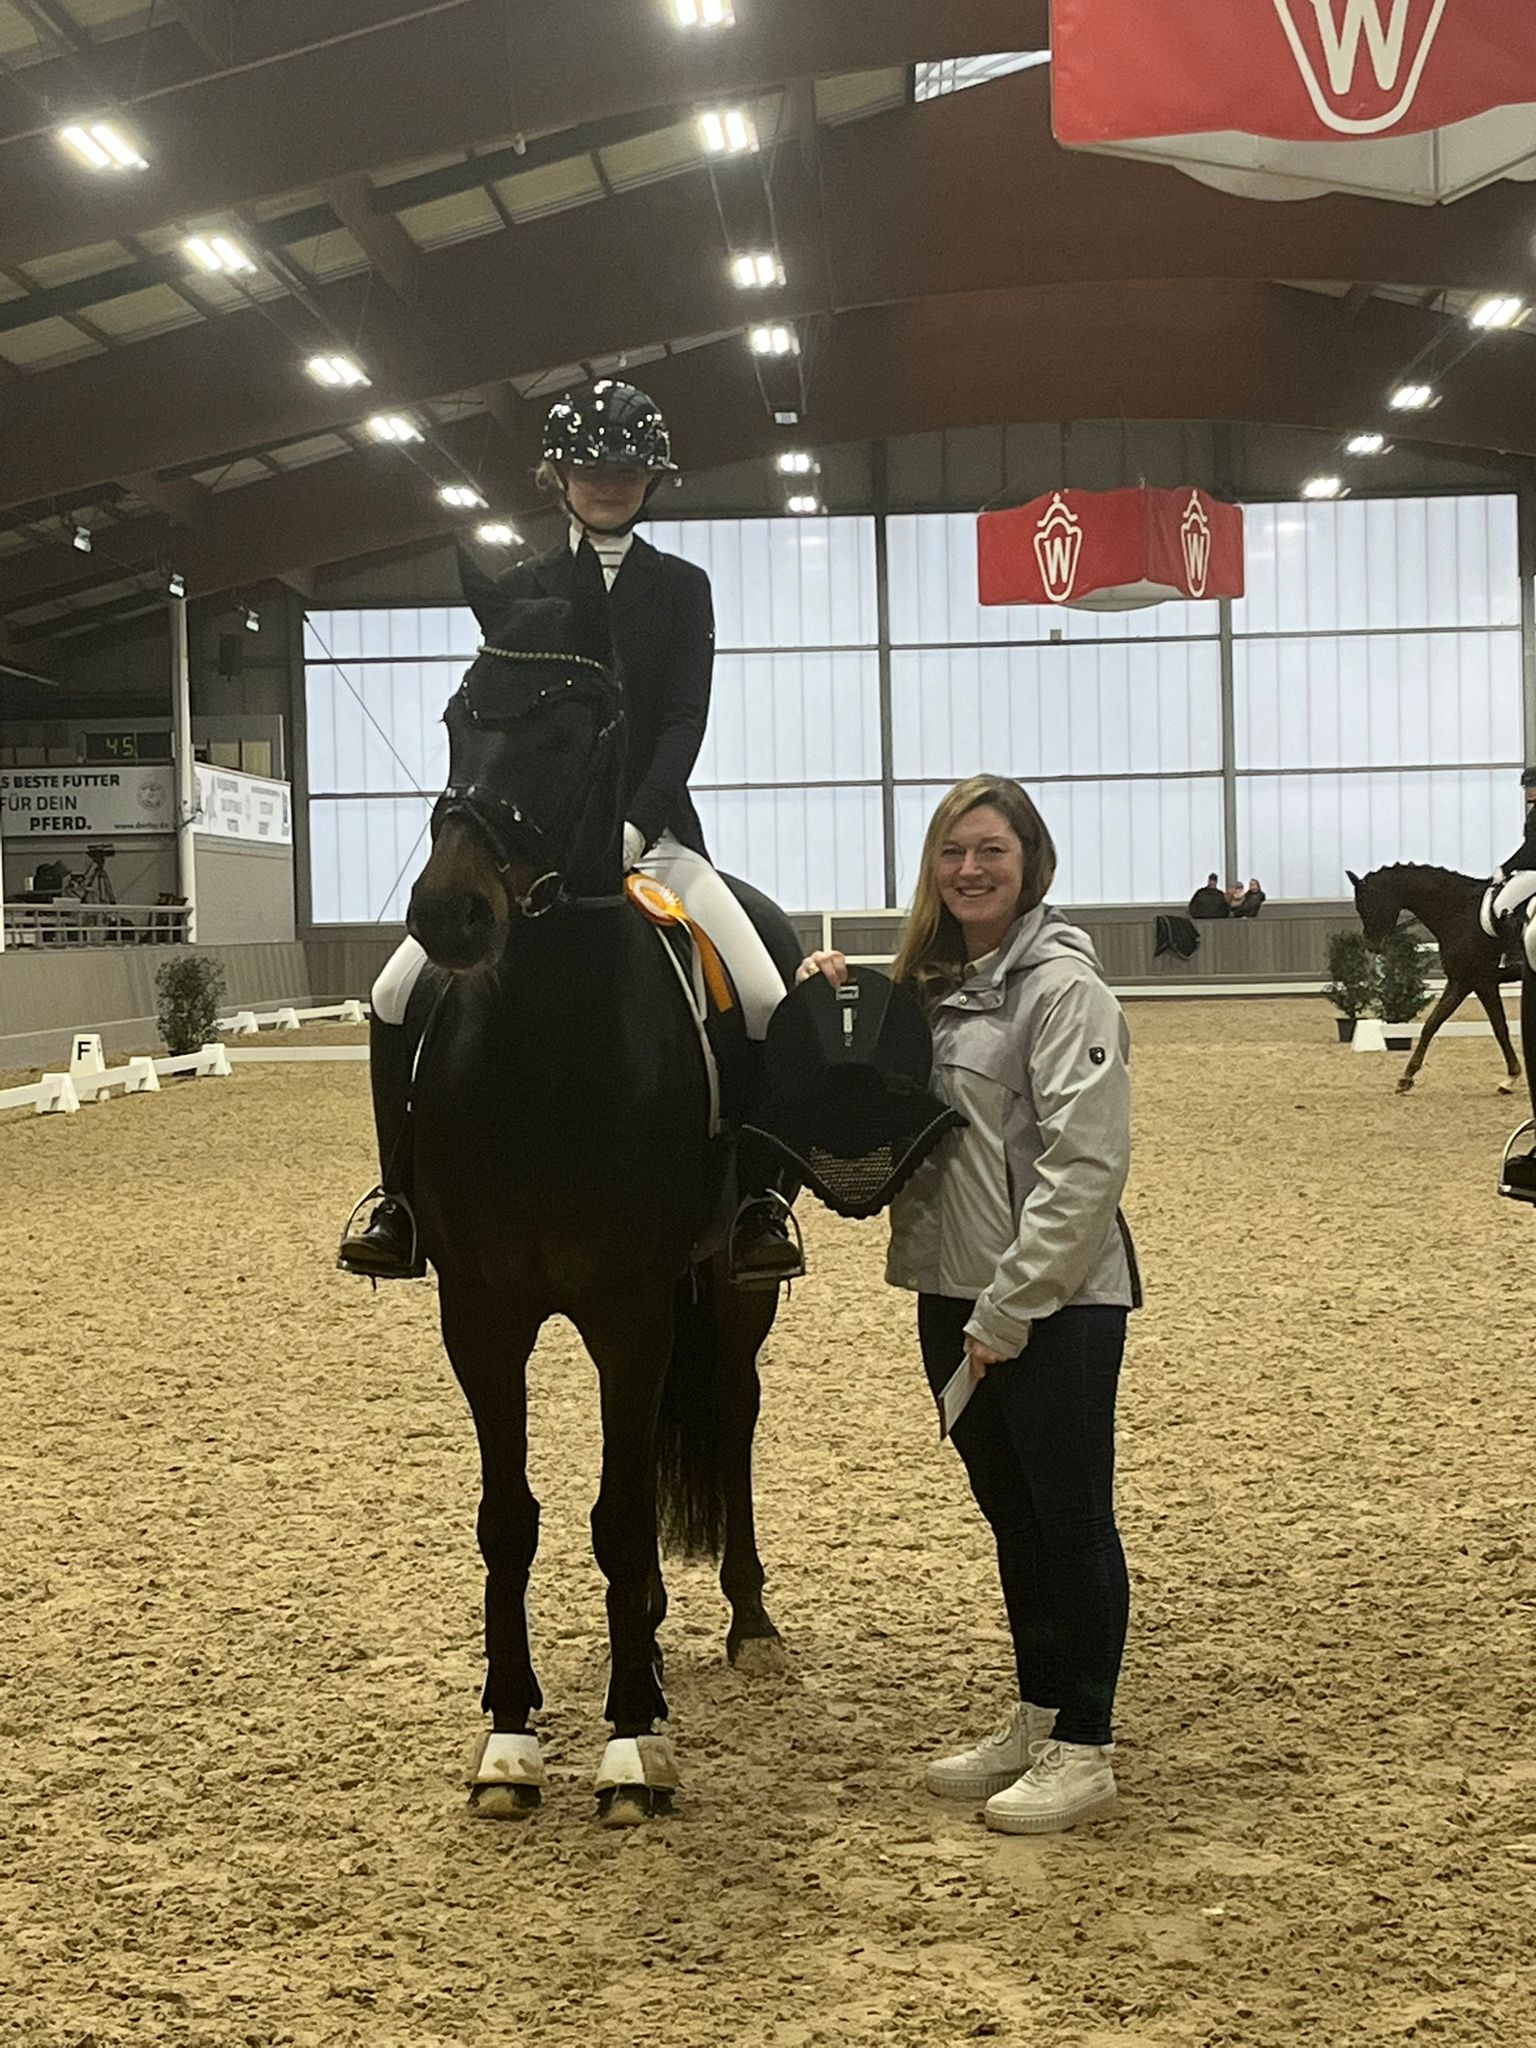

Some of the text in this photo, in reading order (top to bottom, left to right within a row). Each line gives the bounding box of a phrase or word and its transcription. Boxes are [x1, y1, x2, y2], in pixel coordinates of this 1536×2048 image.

[1308, 0, 1410, 96] W
[1043, 536, 1072, 585] W
[1186, 533, 1205, 581] W
[106, 736, 134, 757] 45
[13, 775, 60, 789] BESTE
[62, 774, 120, 788] FUTTER
[0, 792, 77, 812] FÜR DEIN
[30, 816, 92, 831] PFERD.
[77, 1041, 92, 1061] F
